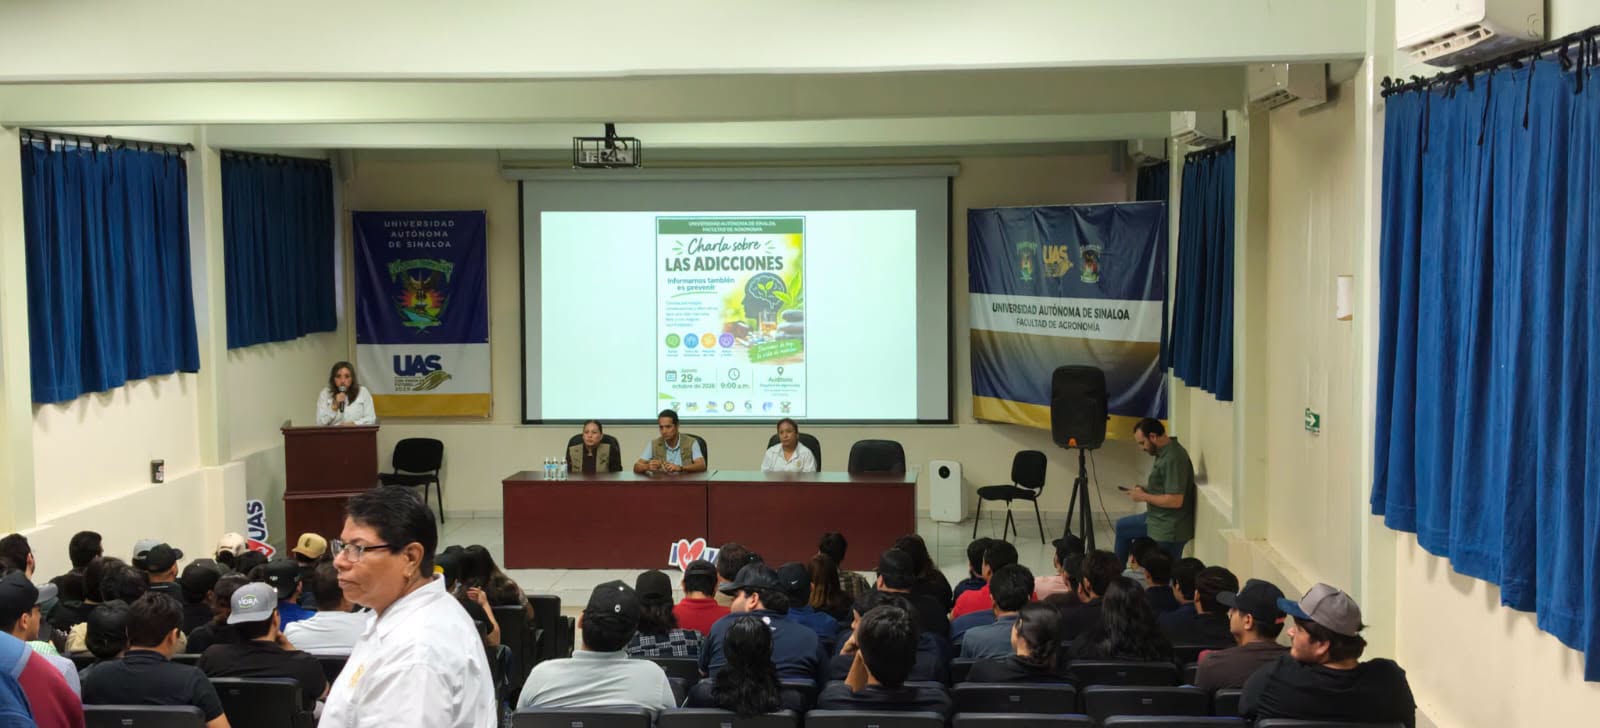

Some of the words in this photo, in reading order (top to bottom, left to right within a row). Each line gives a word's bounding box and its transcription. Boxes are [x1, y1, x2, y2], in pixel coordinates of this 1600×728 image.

[384, 220, 455, 228] UNIVERSIDAD
[391, 229, 449, 238] AUTÓNOMA
[687, 237, 731, 255] Charla
[732, 237, 761, 252] sobre
[1042, 244, 1068, 263] UAS
[665, 257, 691, 272] LAS
[693, 255, 784, 271] ADICCIONES
[992, 302, 1037, 315] UNIVERSIDAD
[1038, 303, 1081, 318] AUTÓNOMA
[1082, 307, 1093, 319] DE
[1094, 307, 1130, 321] SINALOA
[1016, 317, 1047, 328] FACULTAD
[1048, 319, 1057, 329] DE
[393, 354, 442, 377] UAS
[681, 373, 693, 383] 29
[247, 501, 266, 541] UAS
